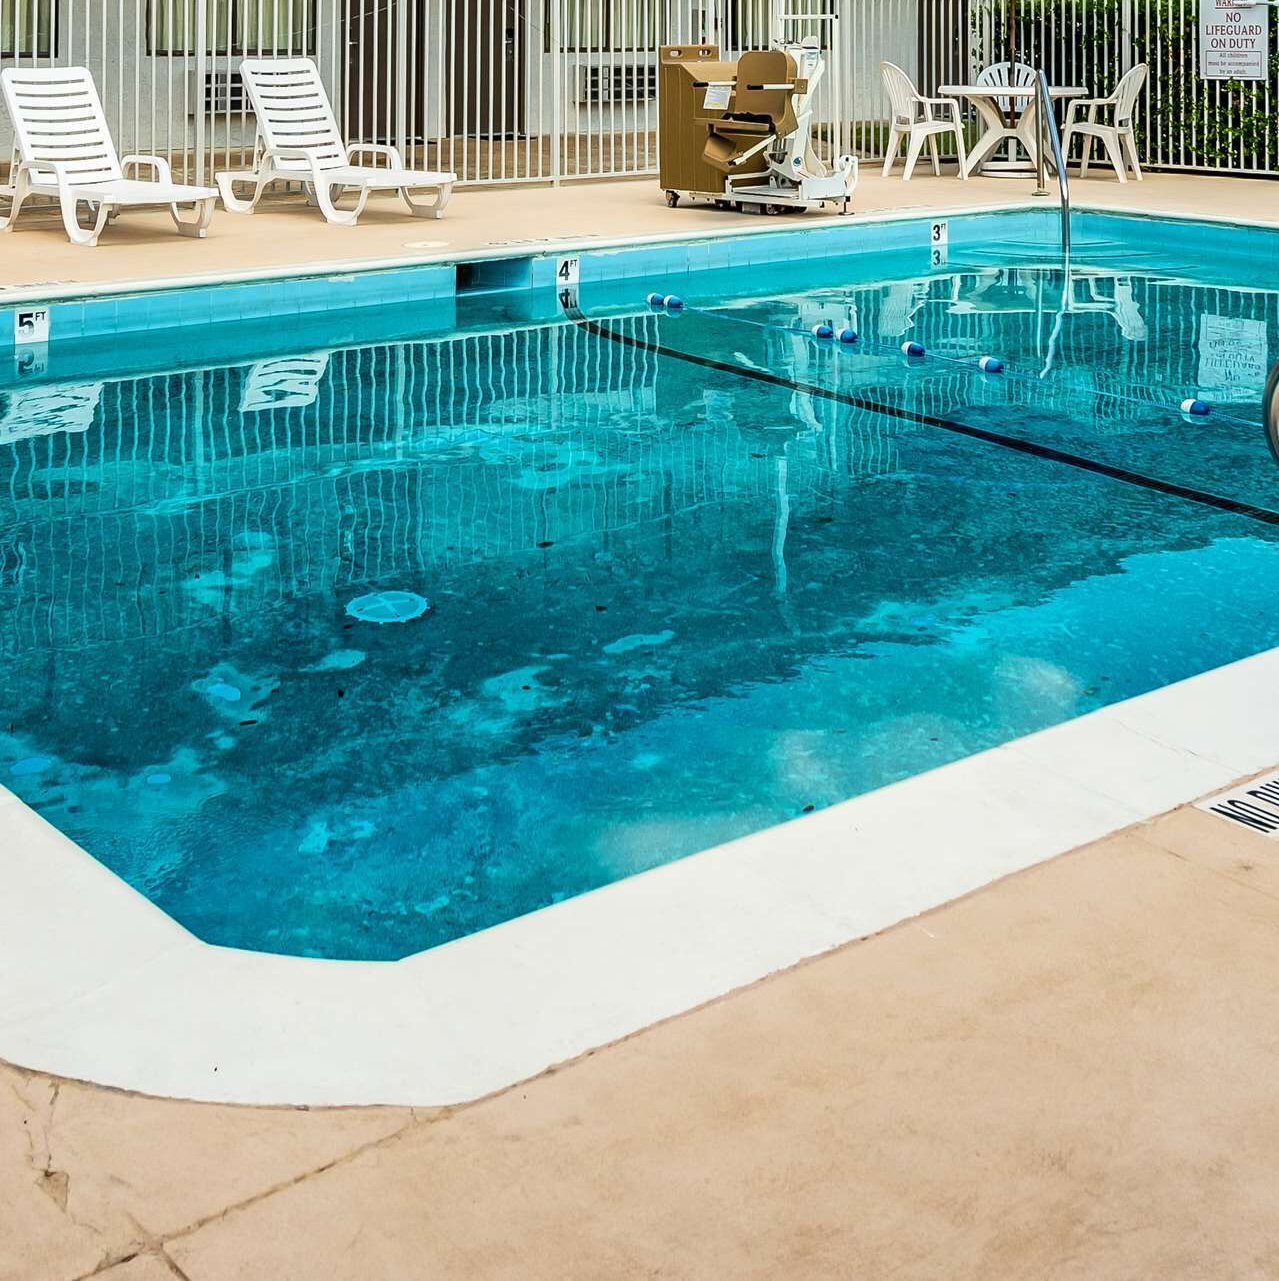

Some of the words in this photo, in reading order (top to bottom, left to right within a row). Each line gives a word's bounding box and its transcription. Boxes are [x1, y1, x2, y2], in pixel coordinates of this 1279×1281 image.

[1226, 12, 1241, 22] NO
[1206, 25, 1262, 35] LIFEGUARD
[1211, 38, 1226, 48] ON
[1229, 38, 1256, 49] DUTY
[933, 224, 941, 241] 3
[558, 260, 570, 281] 4
[570, 259, 577, 267] FT
[18, 312, 34, 335] 5
[35, 311, 46, 321] FT
